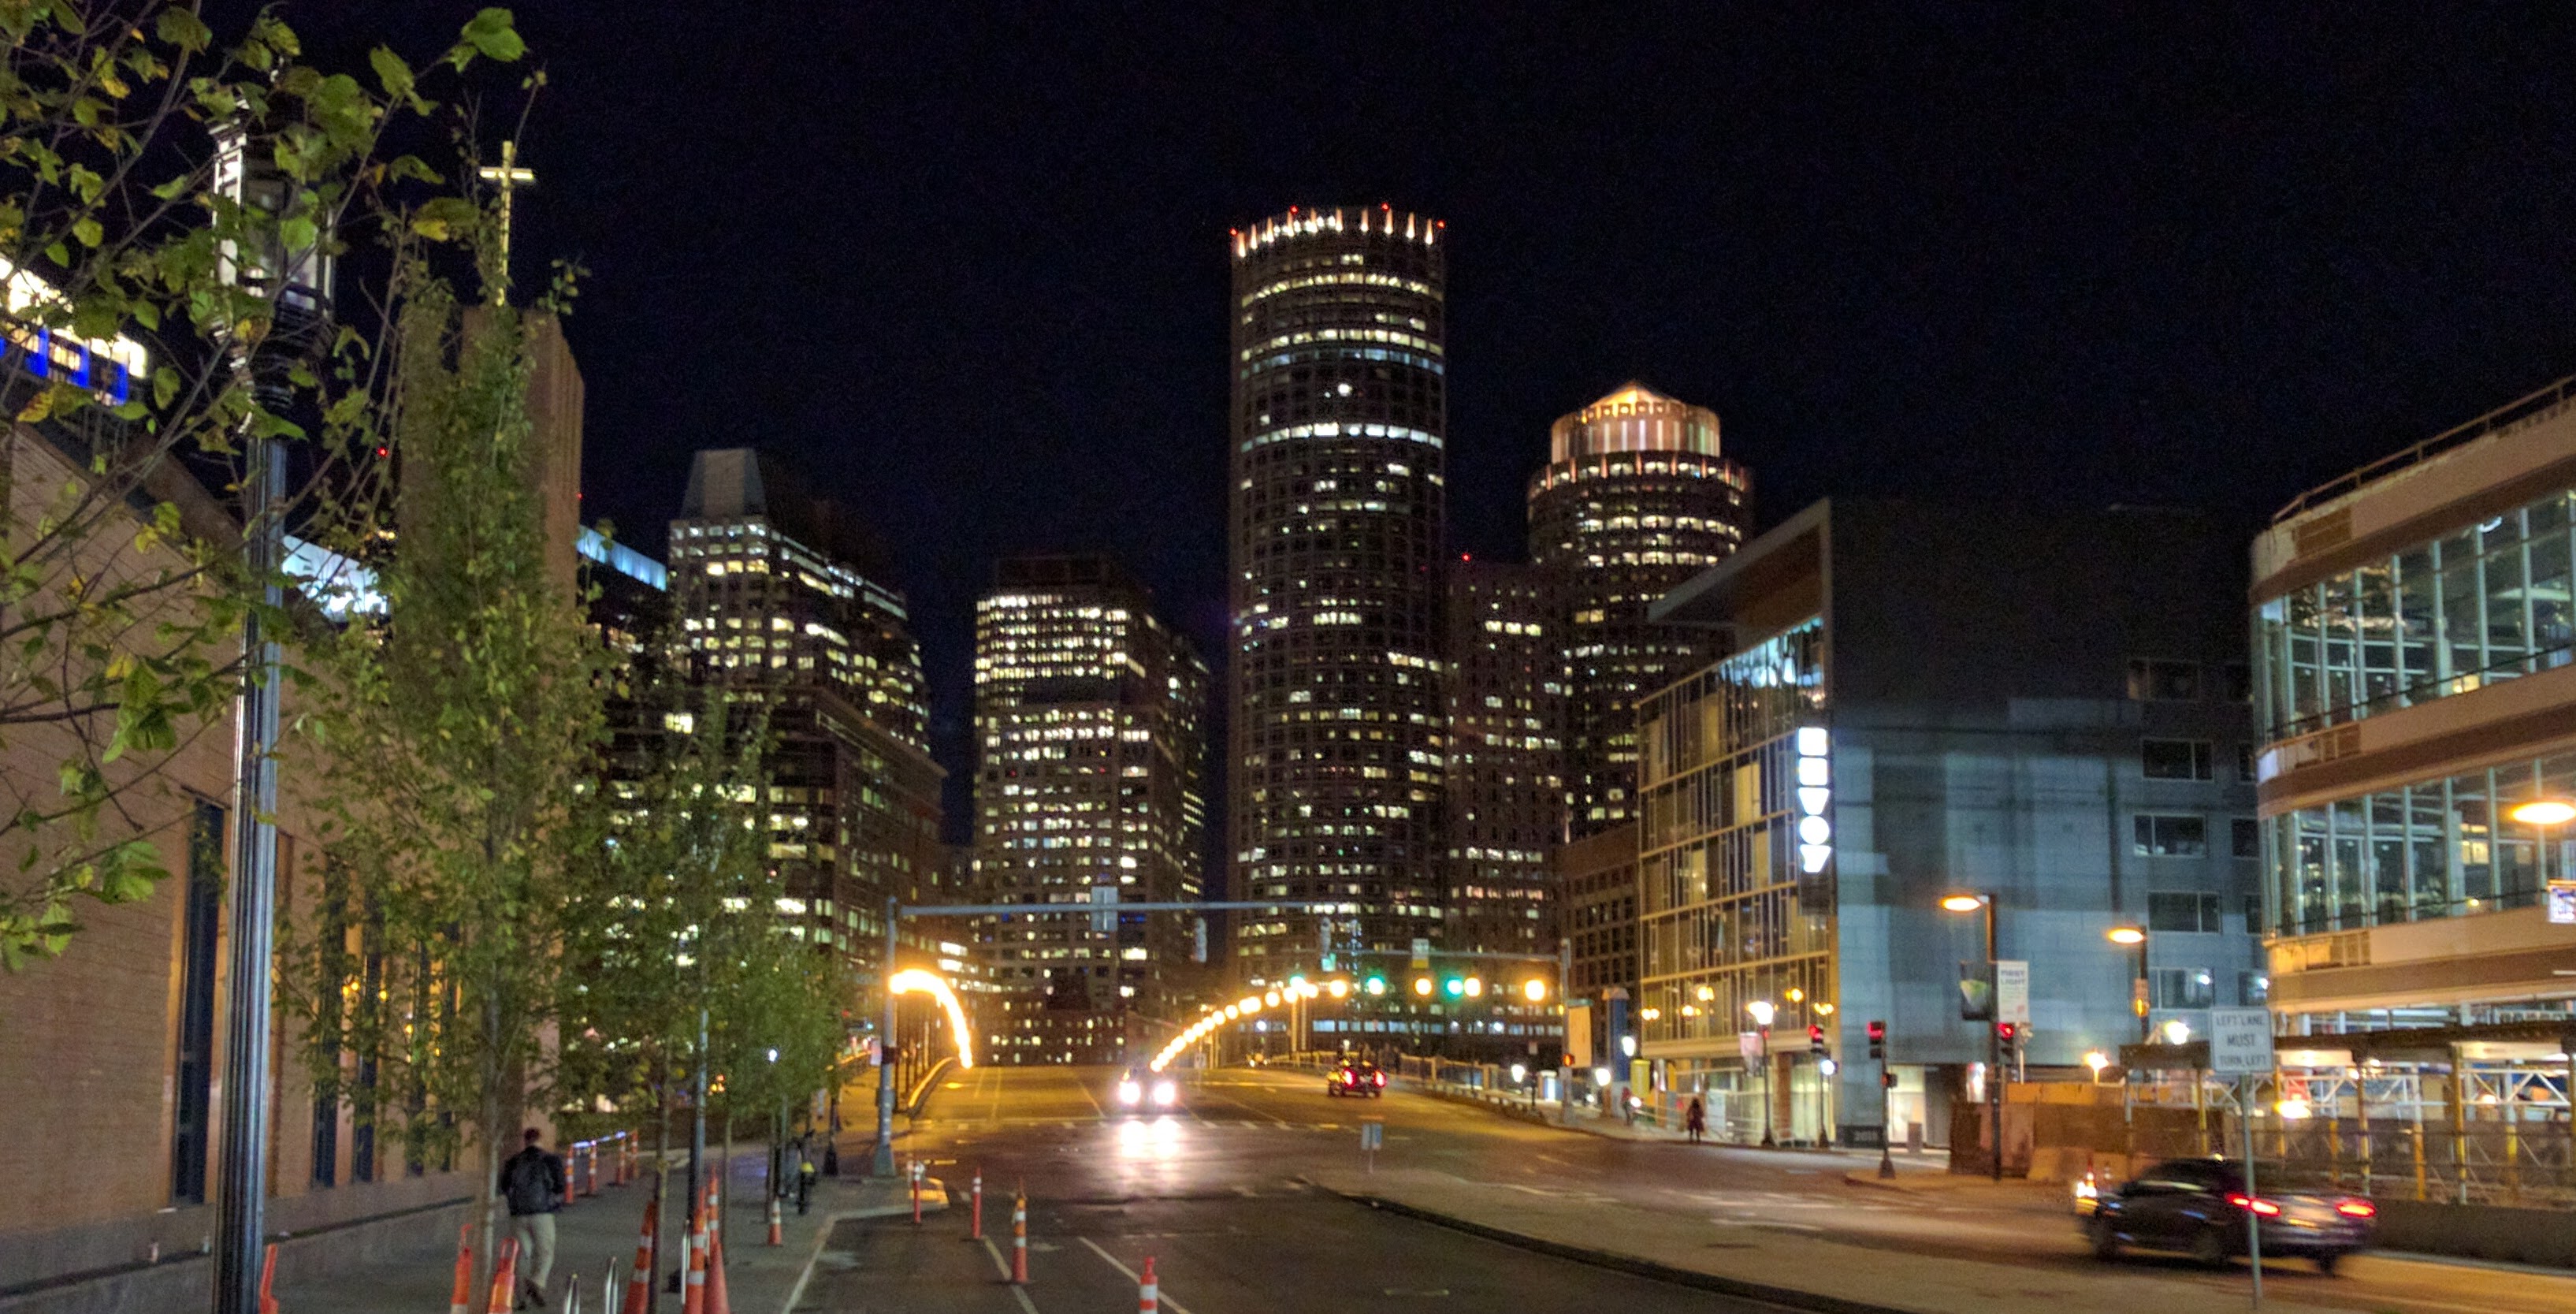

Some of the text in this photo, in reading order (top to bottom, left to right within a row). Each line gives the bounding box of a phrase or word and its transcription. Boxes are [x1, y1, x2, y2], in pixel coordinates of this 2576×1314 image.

[1798, 727, 1831, 873] VOY
[2216, 1014, 2263, 1026] LEFT LANE
[2227, 1033, 2255, 1047] MUST
[2220, 1054, 2266, 1066] TURN LEFT
